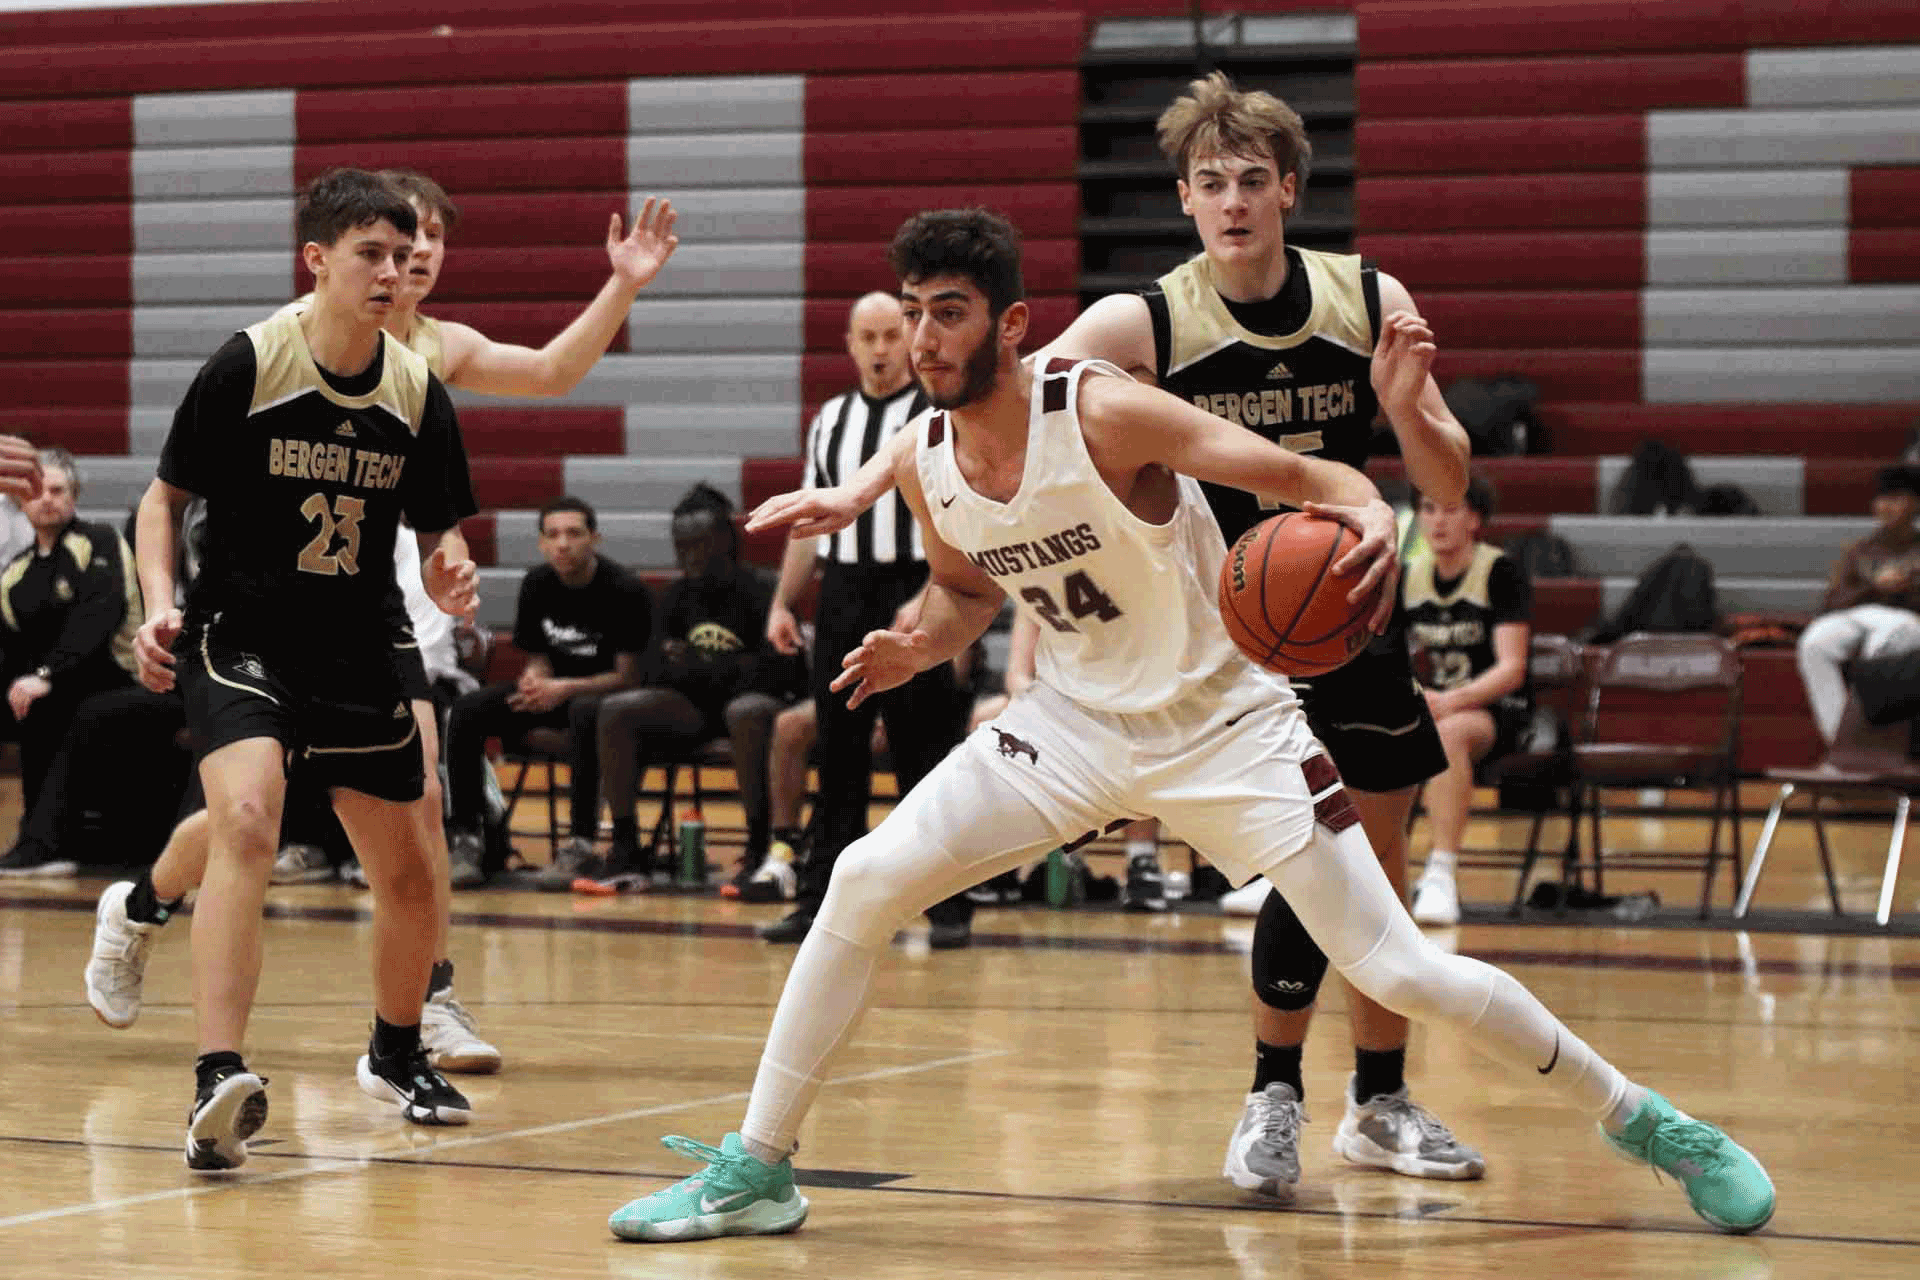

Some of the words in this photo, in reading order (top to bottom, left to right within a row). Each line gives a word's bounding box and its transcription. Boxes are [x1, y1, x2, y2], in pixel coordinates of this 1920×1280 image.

[1297, 380, 1355, 421] TECH
[269, 438, 351, 482] BERGEN
[353, 449, 406, 489] TECH
[297, 492, 366, 576] 23
[967, 523, 1102, 577] MUSTANGS
